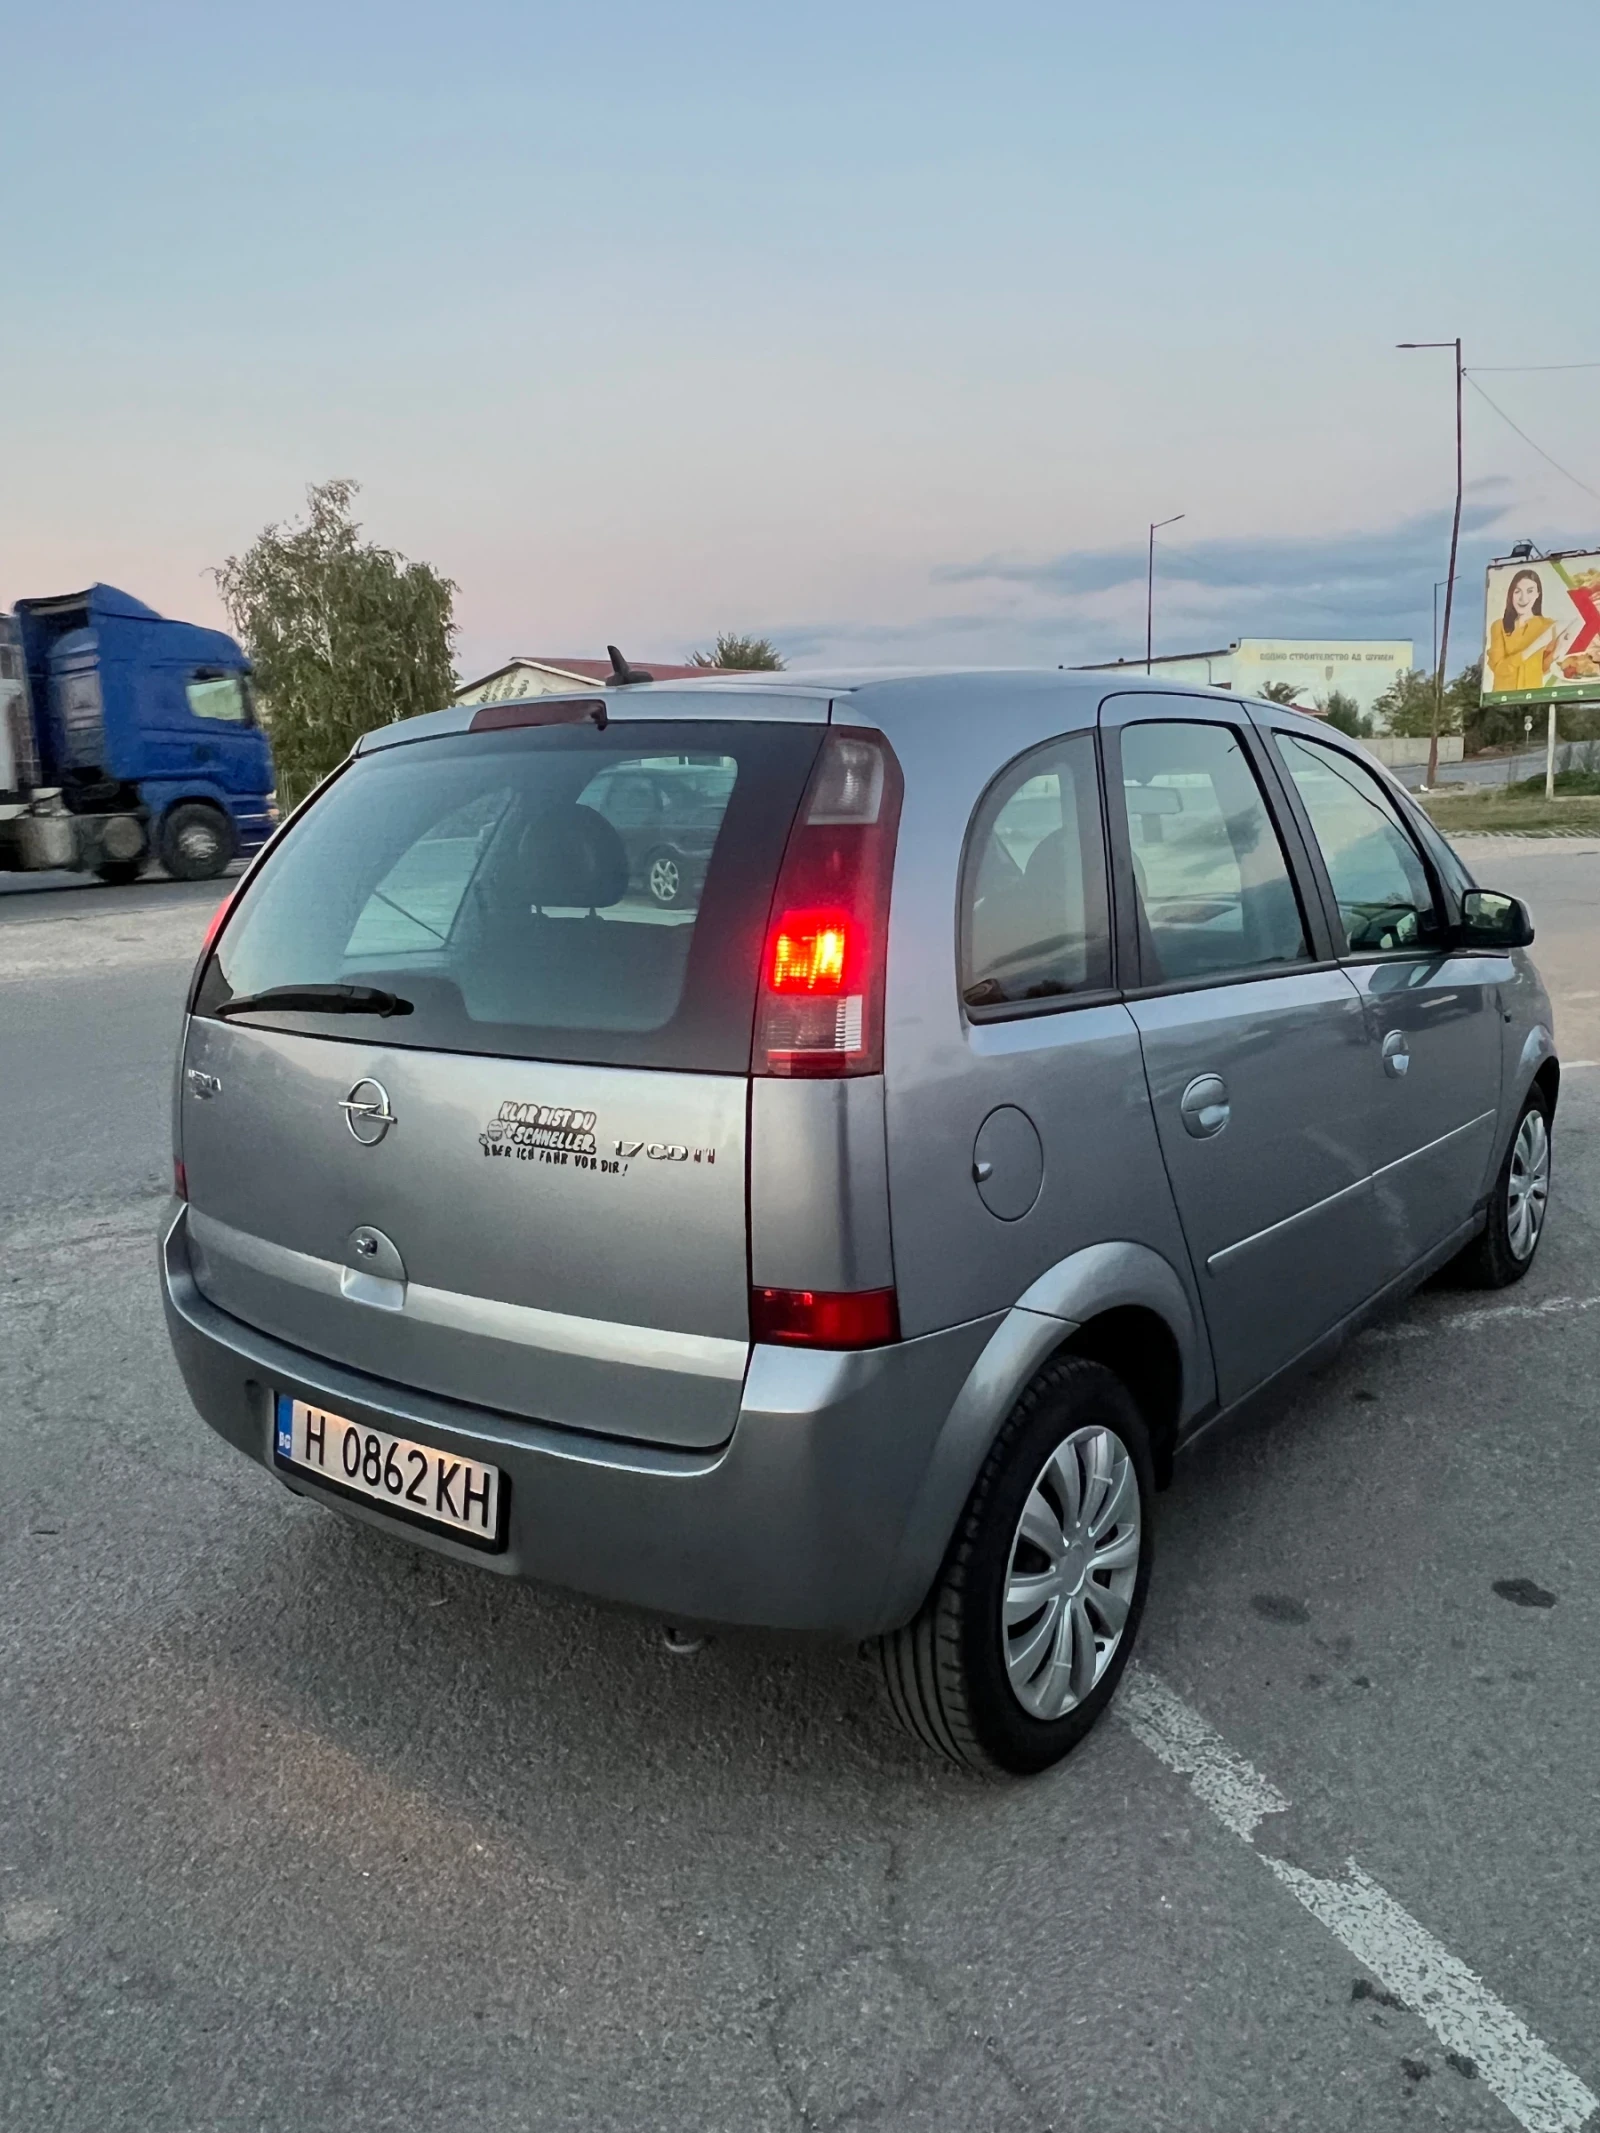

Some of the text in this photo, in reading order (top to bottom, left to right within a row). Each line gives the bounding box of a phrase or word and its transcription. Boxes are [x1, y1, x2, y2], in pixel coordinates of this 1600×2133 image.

[499, 1101, 538, 1124] KLAR
[571, 1110, 596, 1131] DU
[513, 1126, 597, 1154] SCHNELLER
[516, 1147, 535, 1160] ICH
[539, 1150, 569, 1165] FAHR
[575, 1155, 597, 1170] VOR
[279, 1432, 292, 1450] BG
[305, 1410, 326, 1466] H
